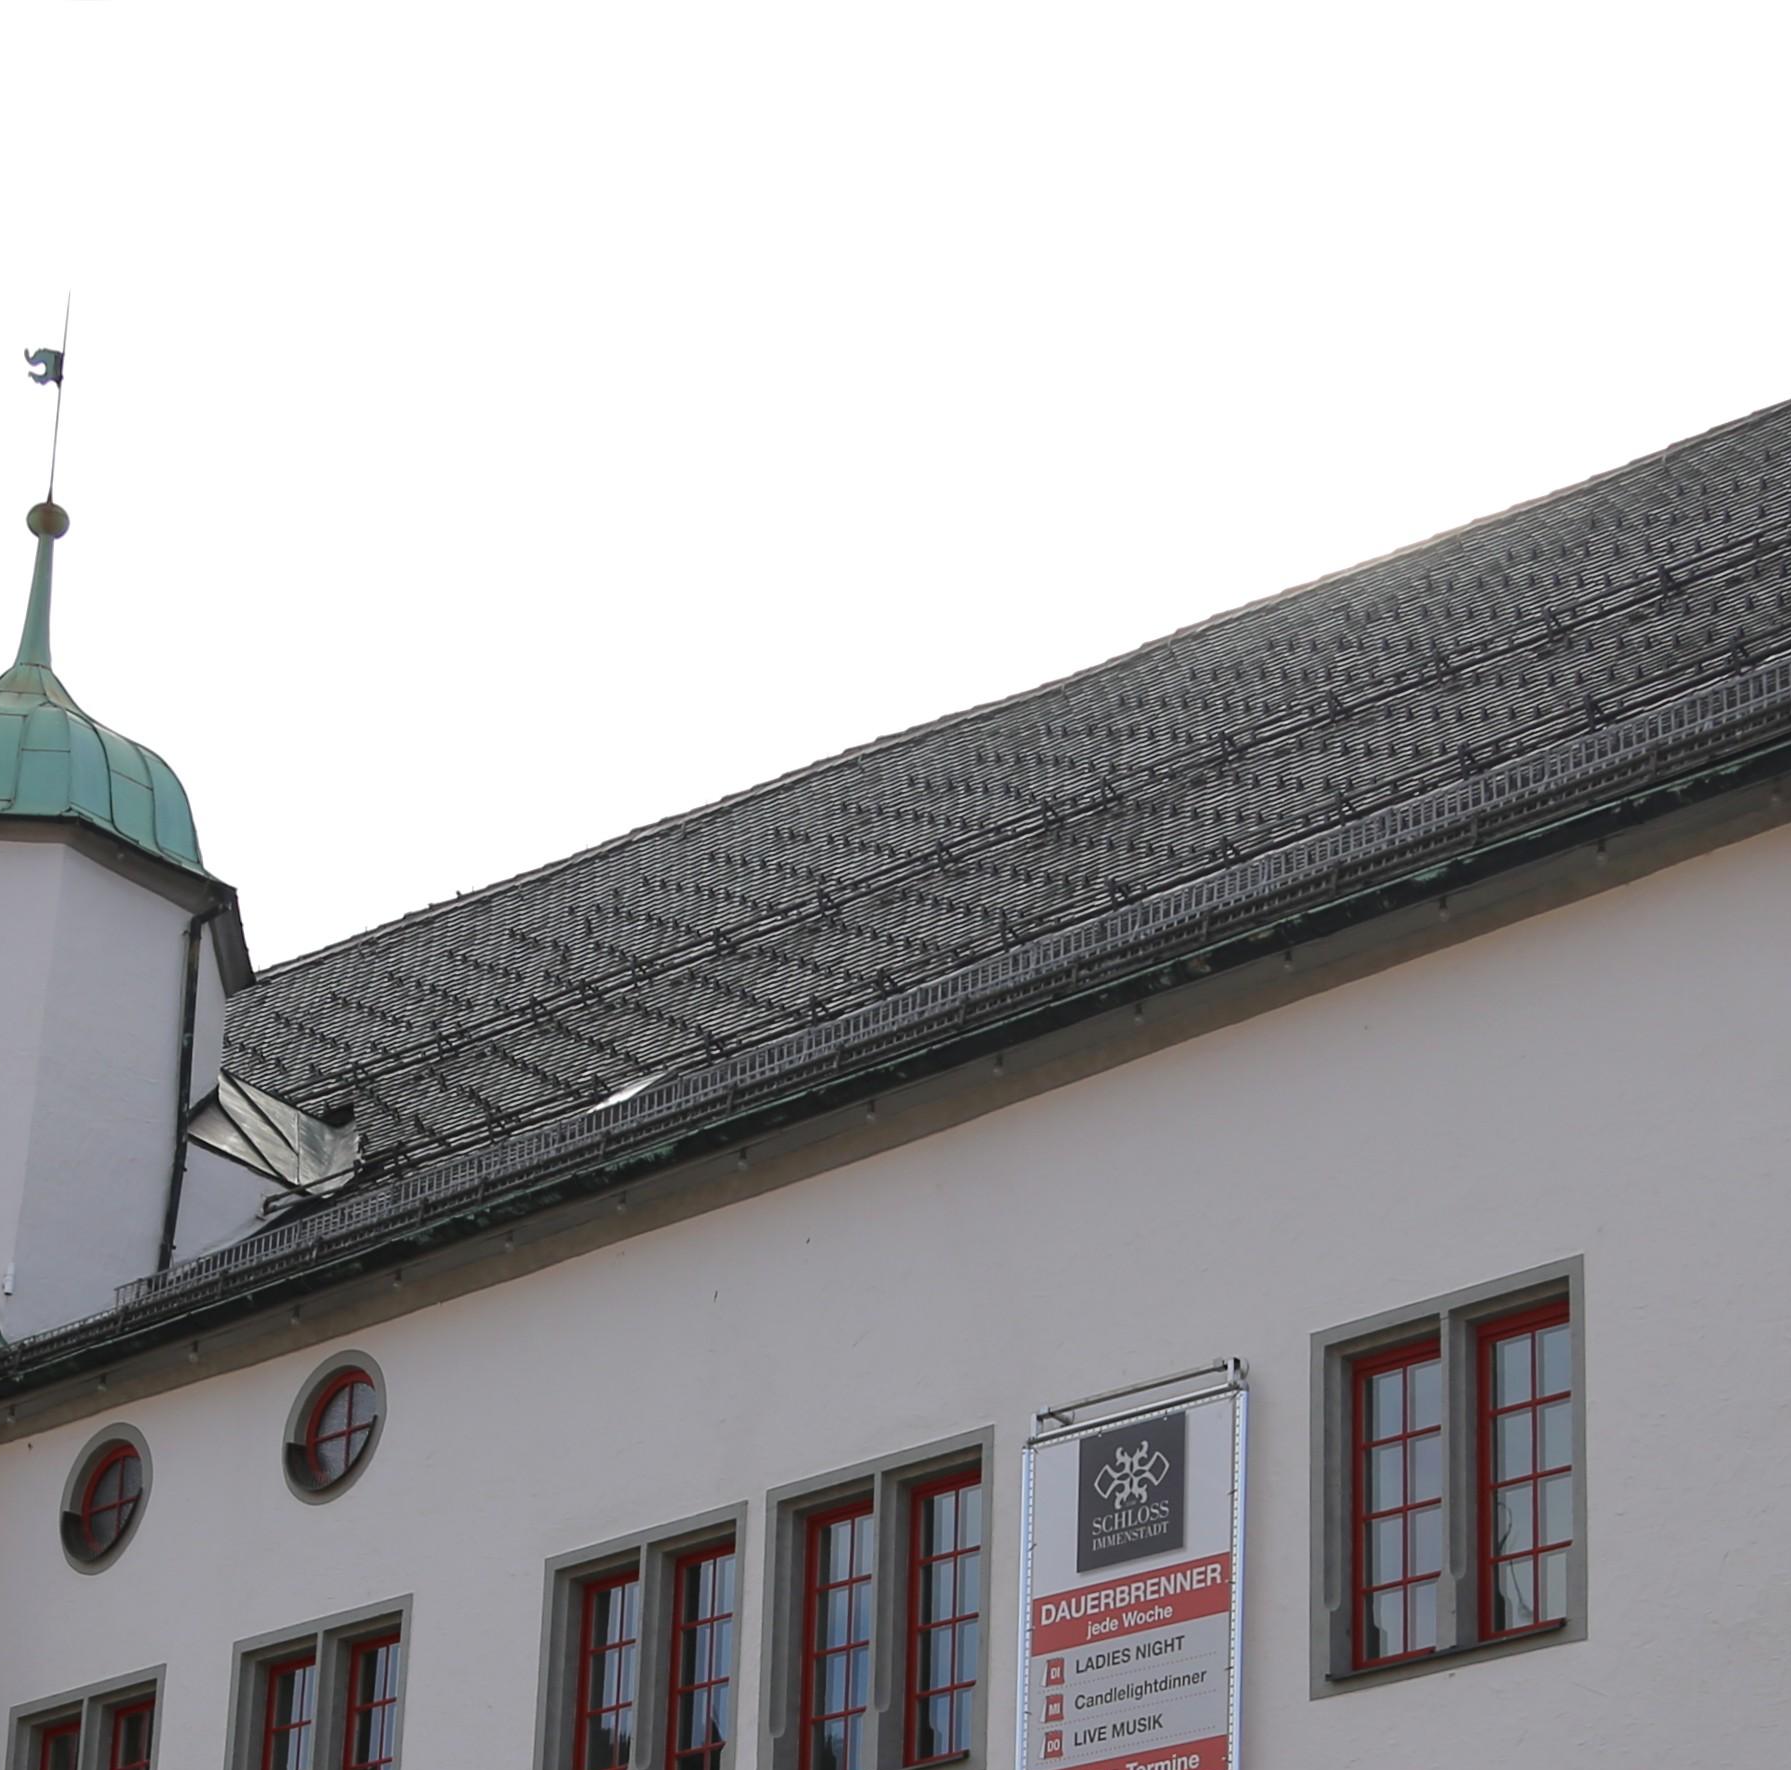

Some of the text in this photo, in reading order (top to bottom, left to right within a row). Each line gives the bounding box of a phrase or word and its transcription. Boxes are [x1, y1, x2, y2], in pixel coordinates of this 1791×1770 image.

[1092, 1499, 1169, 1536] SCHLOSS
[1092, 1520, 1168, 1551] IMMENSTADT
[1040, 1562, 1221, 1625] DAUERBRENNER
[1086, 1602, 1172, 1639] jede Woche
[1050, 1666, 1060, 1679] DI
[1075, 1634, 1184, 1674] LADIES NIGHT
[1074, 1671, 1206, 1710] Candlelightdinner
[1047, 1739, 1060, 1751] DO
[1074, 1713, 1163, 1746] LIVE MUSIK
